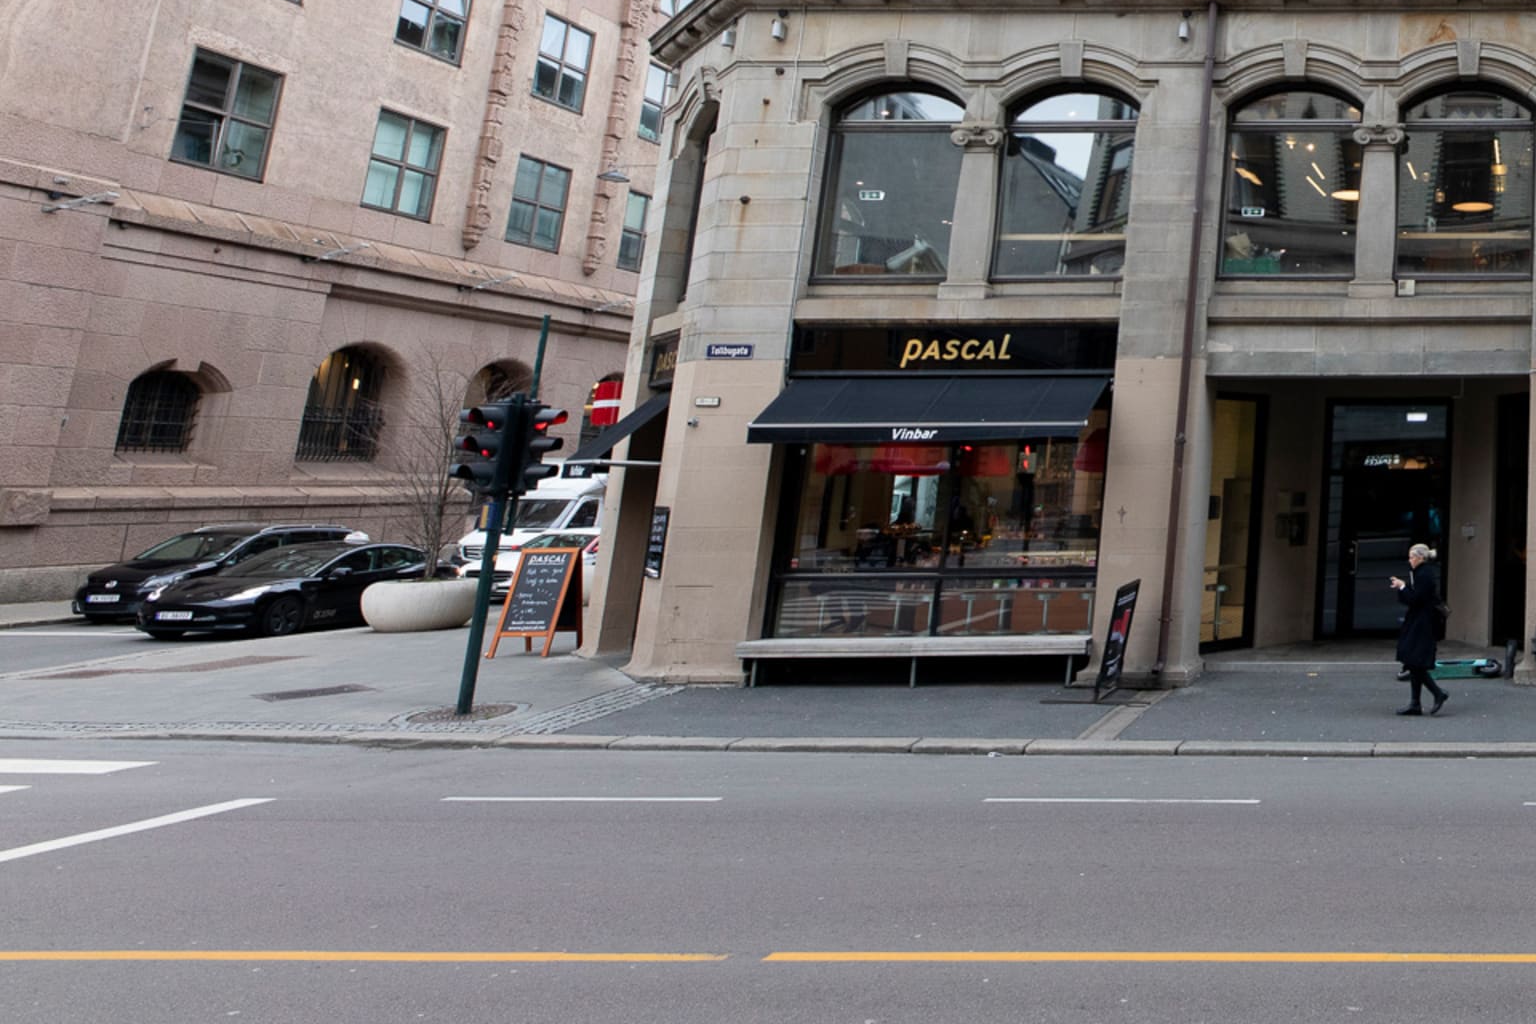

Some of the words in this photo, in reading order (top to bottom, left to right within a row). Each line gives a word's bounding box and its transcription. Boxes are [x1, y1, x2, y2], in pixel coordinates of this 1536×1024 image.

[899, 333, 1012, 369] PASCAL
[891, 427, 939, 441] Vinbar
[528, 554, 567, 565] PASCAL
